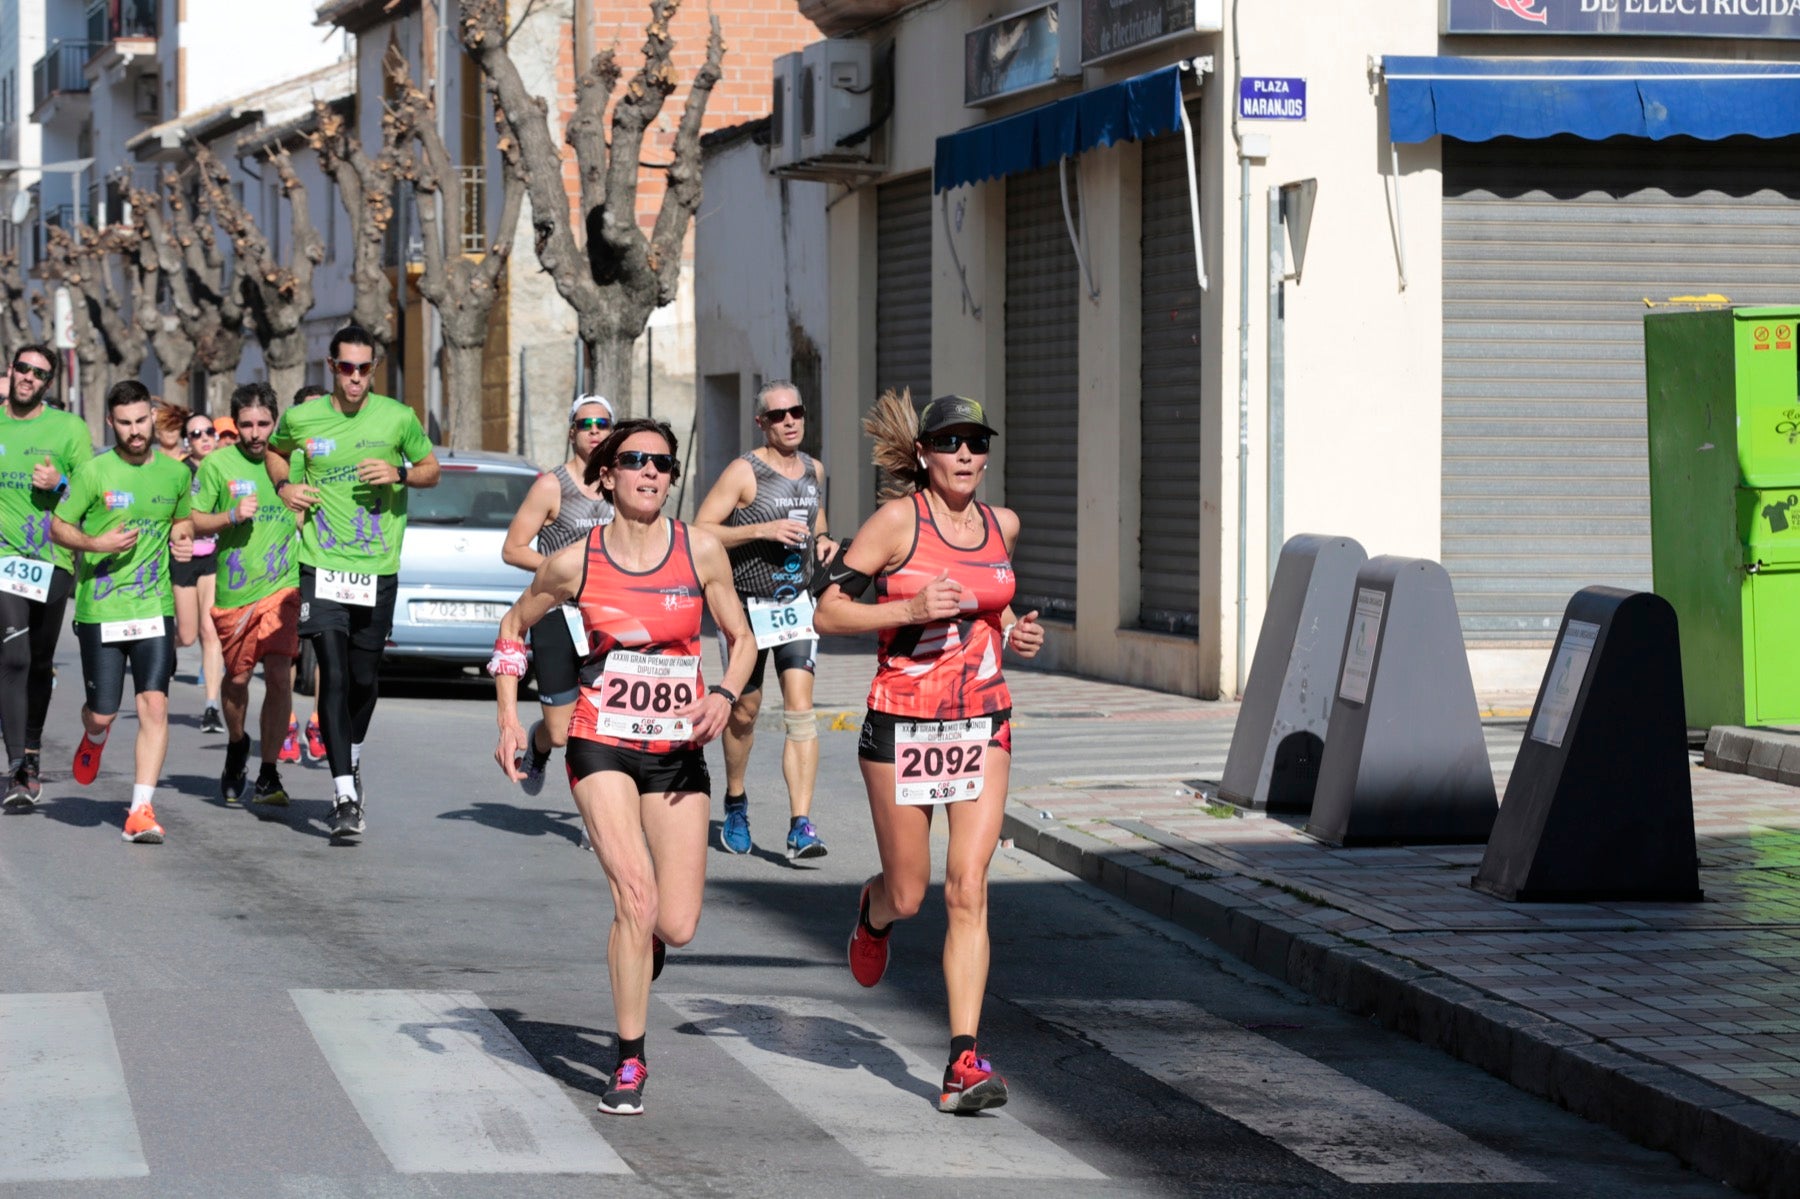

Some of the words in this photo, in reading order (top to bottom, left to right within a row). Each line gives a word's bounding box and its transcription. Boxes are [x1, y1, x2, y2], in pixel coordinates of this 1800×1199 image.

[1254, 80, 1290, 93] PLAZA
[1243, 98, 1303, 117] NARANJOS
[4, 560, 43, 583] 430
[771, 607, 798, 628] 56
[630, 654, 647, 665] GRAN
[606, 677, 692, 713] 2089
[967, 720, 987, 730] ONDO
[901, 744, 983, 778] 2092
